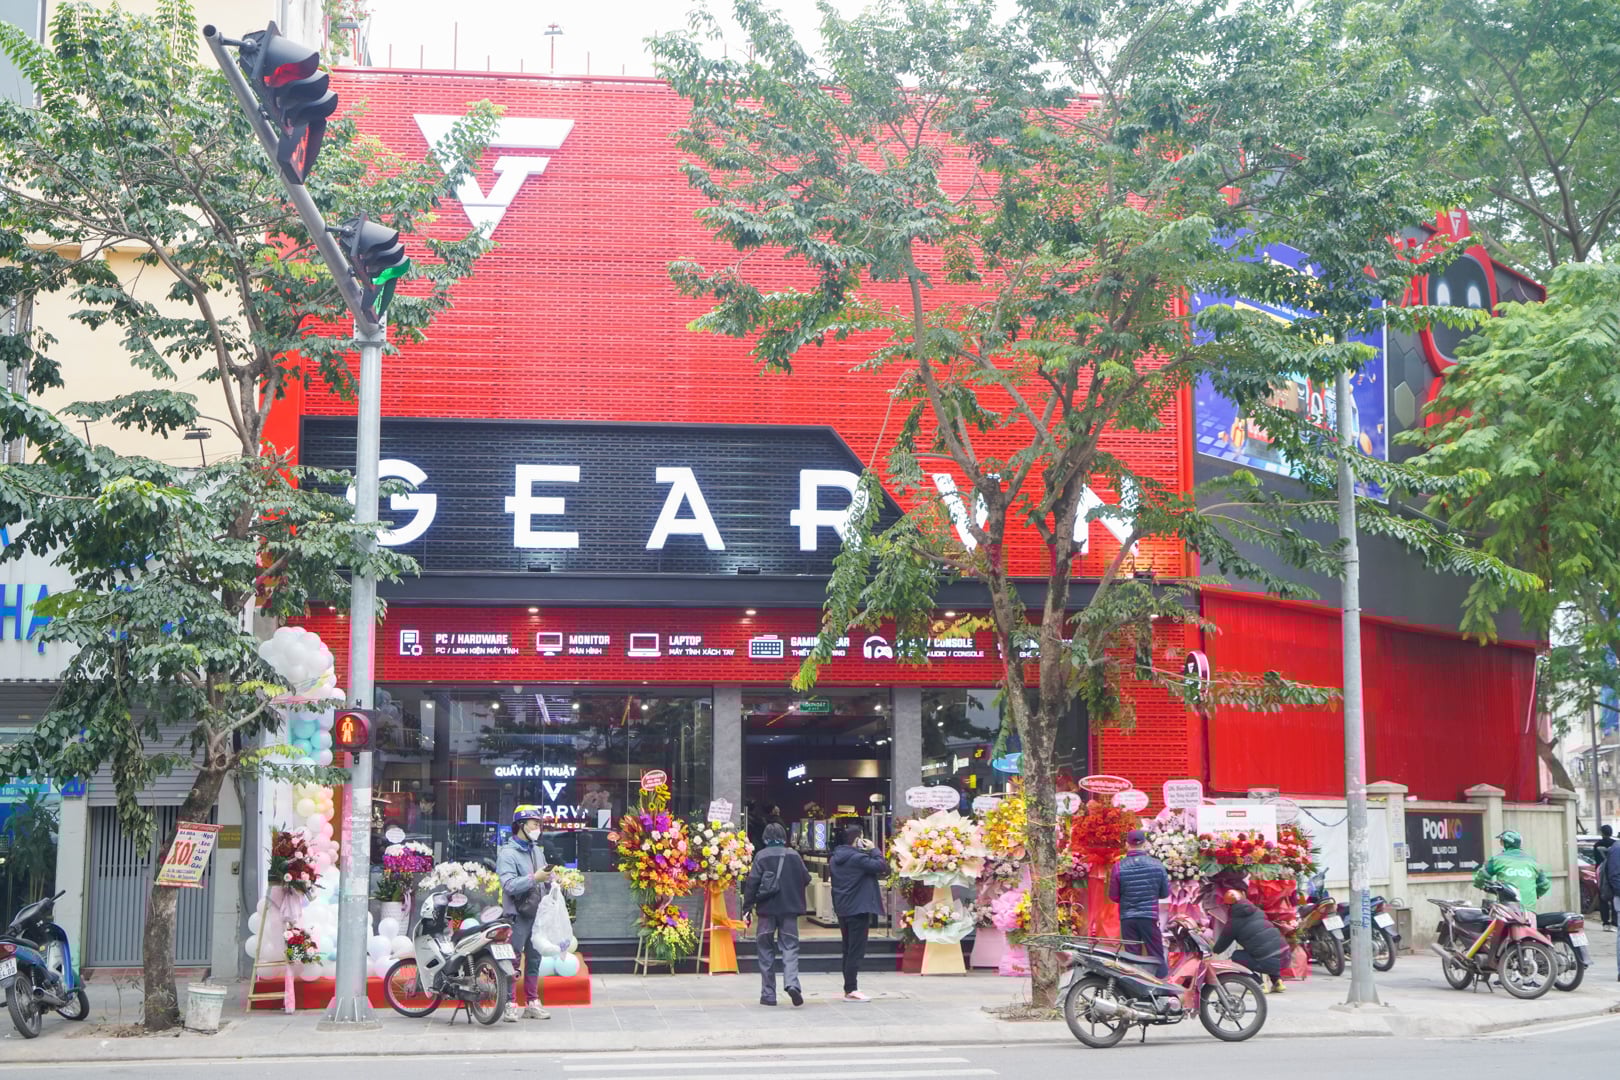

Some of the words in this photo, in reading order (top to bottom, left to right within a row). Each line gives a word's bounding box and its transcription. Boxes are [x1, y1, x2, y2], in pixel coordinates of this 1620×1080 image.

[436, 634, 448, 645] PC
[458, 634, 508, 645] HARDWARE
[569, 635, 610, 645] MONITOR
[669, 635, 702, 646] LAPTOP
[791, 637, 823, 647] GAMIN
[452, 647, 469, 655] LINH
[722, 648, 735, 656] TAY
[1505, 867, 1533, 878] Grab
